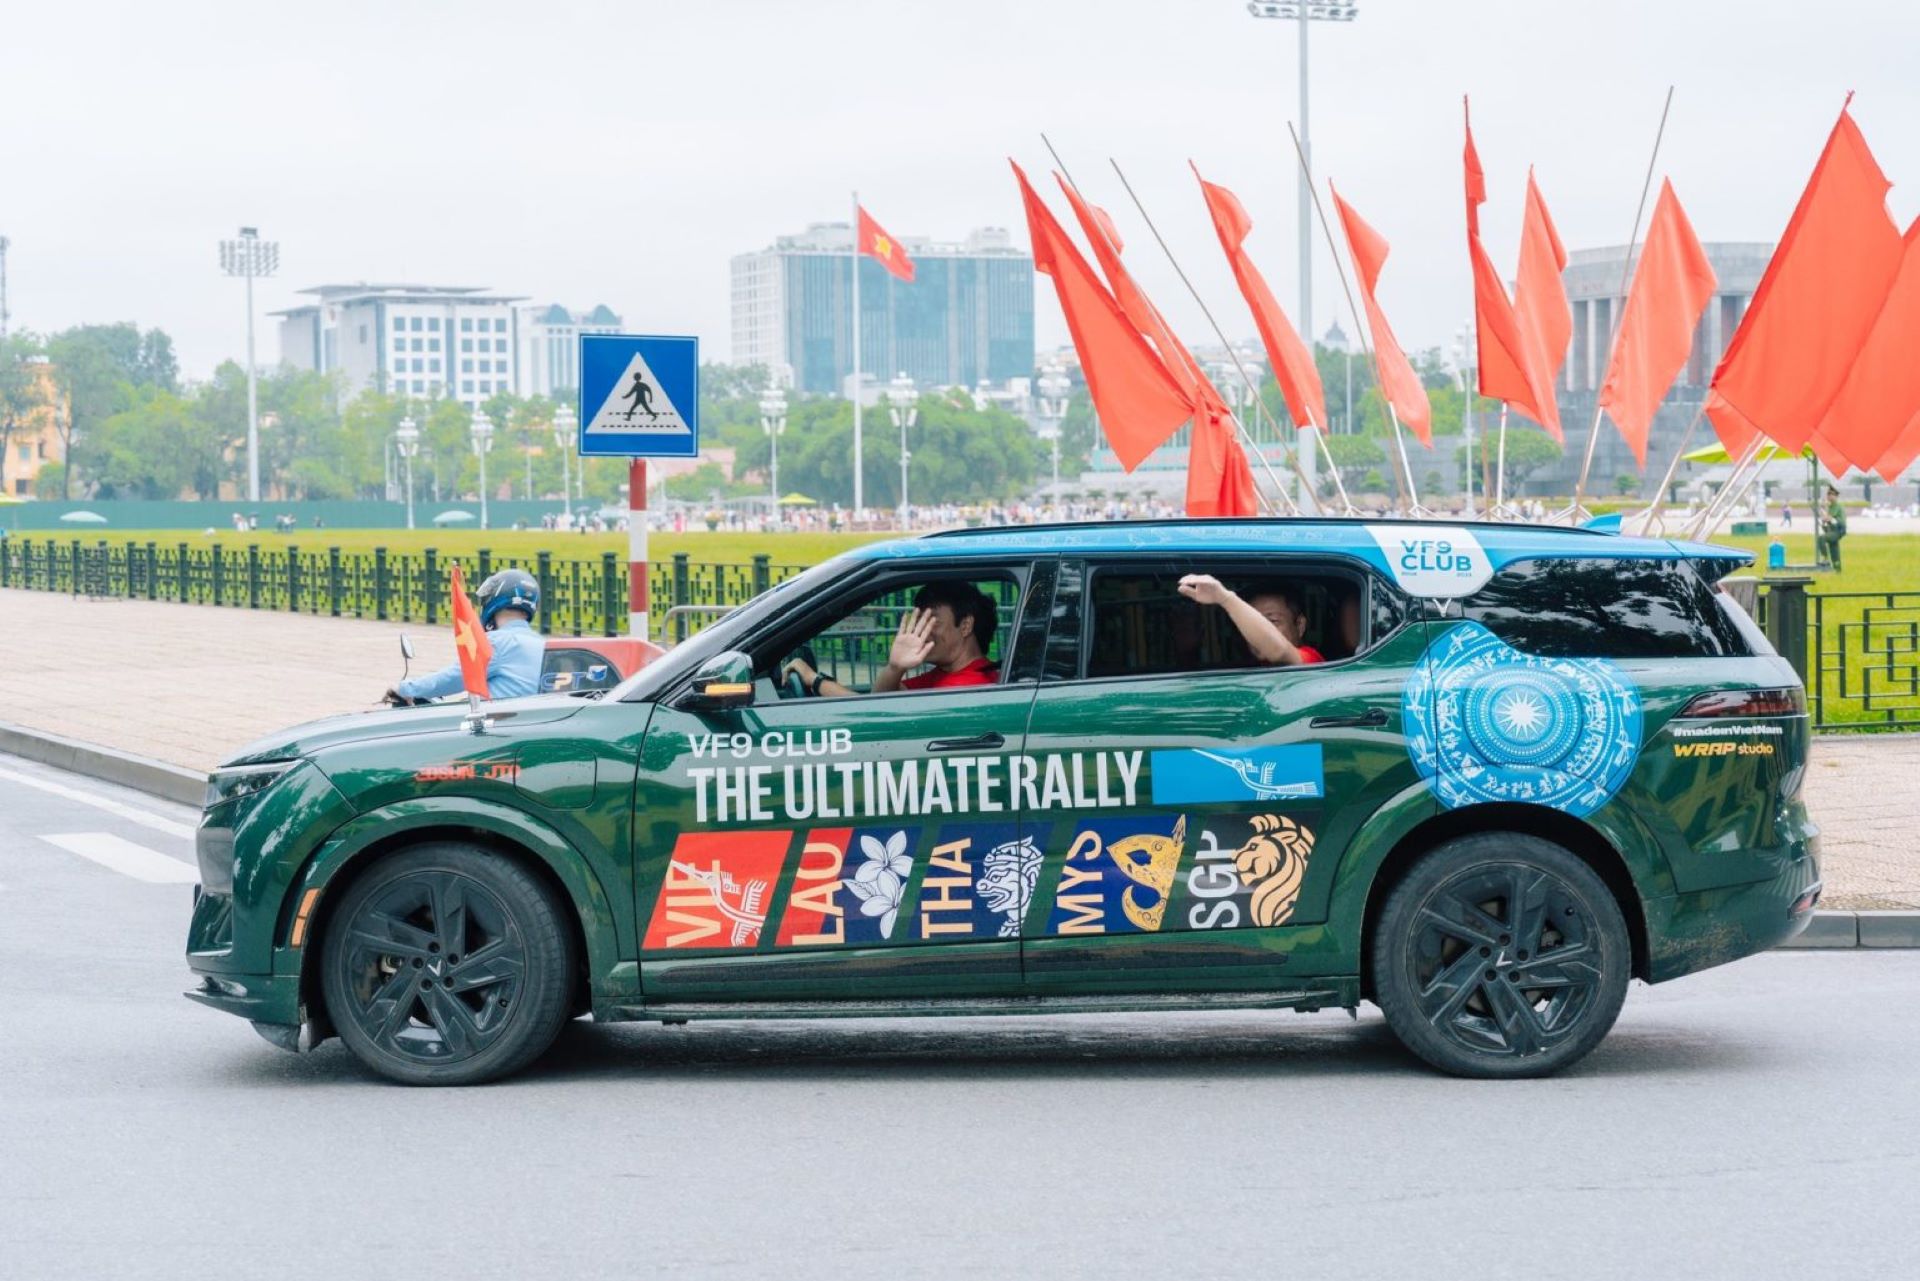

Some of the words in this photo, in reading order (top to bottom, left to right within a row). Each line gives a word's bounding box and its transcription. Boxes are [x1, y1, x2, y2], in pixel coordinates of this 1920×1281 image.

[1400, 540, 1452, 554] VF9
[1400, 554, 1472, 571] CLUB
[688, 732, 753, 759] VF9
[760, 728, 853, 758] CLUB
[1674, 742, 1737, 757] WRAP
[1738, 742, 1774, 754] studio
[687, 765, 774, 823] THE
[783, 757, 1003, 819] ULTIMATE
[1009, 750, 1143, 811] RALLY
[921, 837, 973, 939] THA
[1056, 830, 1106, 934] MYS
[1188, 830, 1240, 929] SGP
